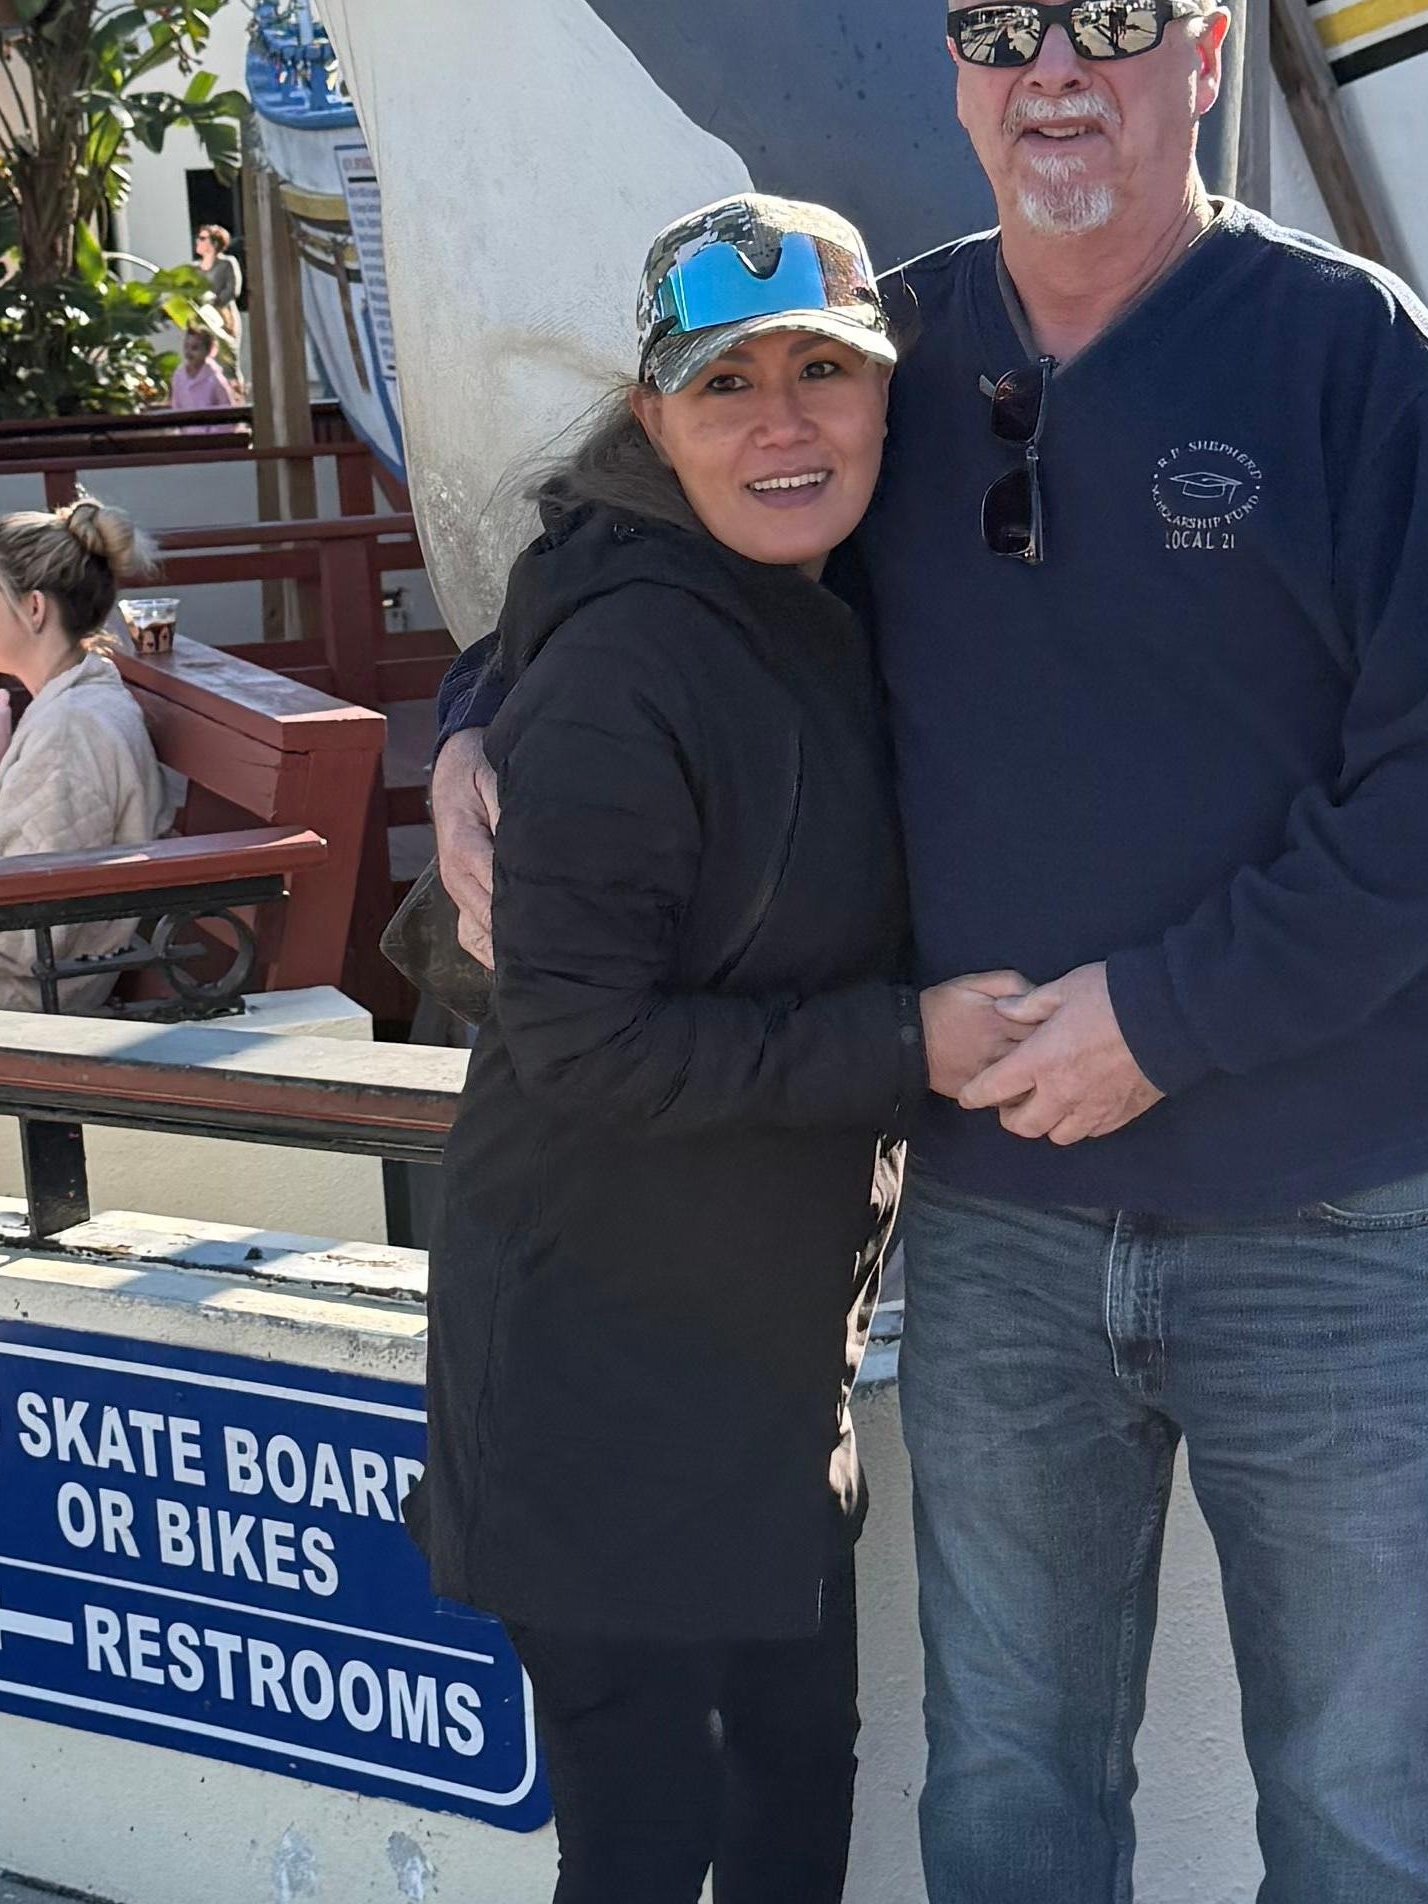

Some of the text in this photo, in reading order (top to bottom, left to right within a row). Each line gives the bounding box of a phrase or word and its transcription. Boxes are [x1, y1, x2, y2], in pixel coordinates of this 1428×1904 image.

[1187, 440, 1262, 480] SHEPHERD
[1151, 484, 1260, 530] SCHOLARSHIP FUND
[1165, 530, 1215, 549] LOCAL
[18, 1391, 205, 1487] SKATE
[57, 1482, 339, 1597] OR BIKES
[84, 1603, 484, 1758] RESTROOMS
